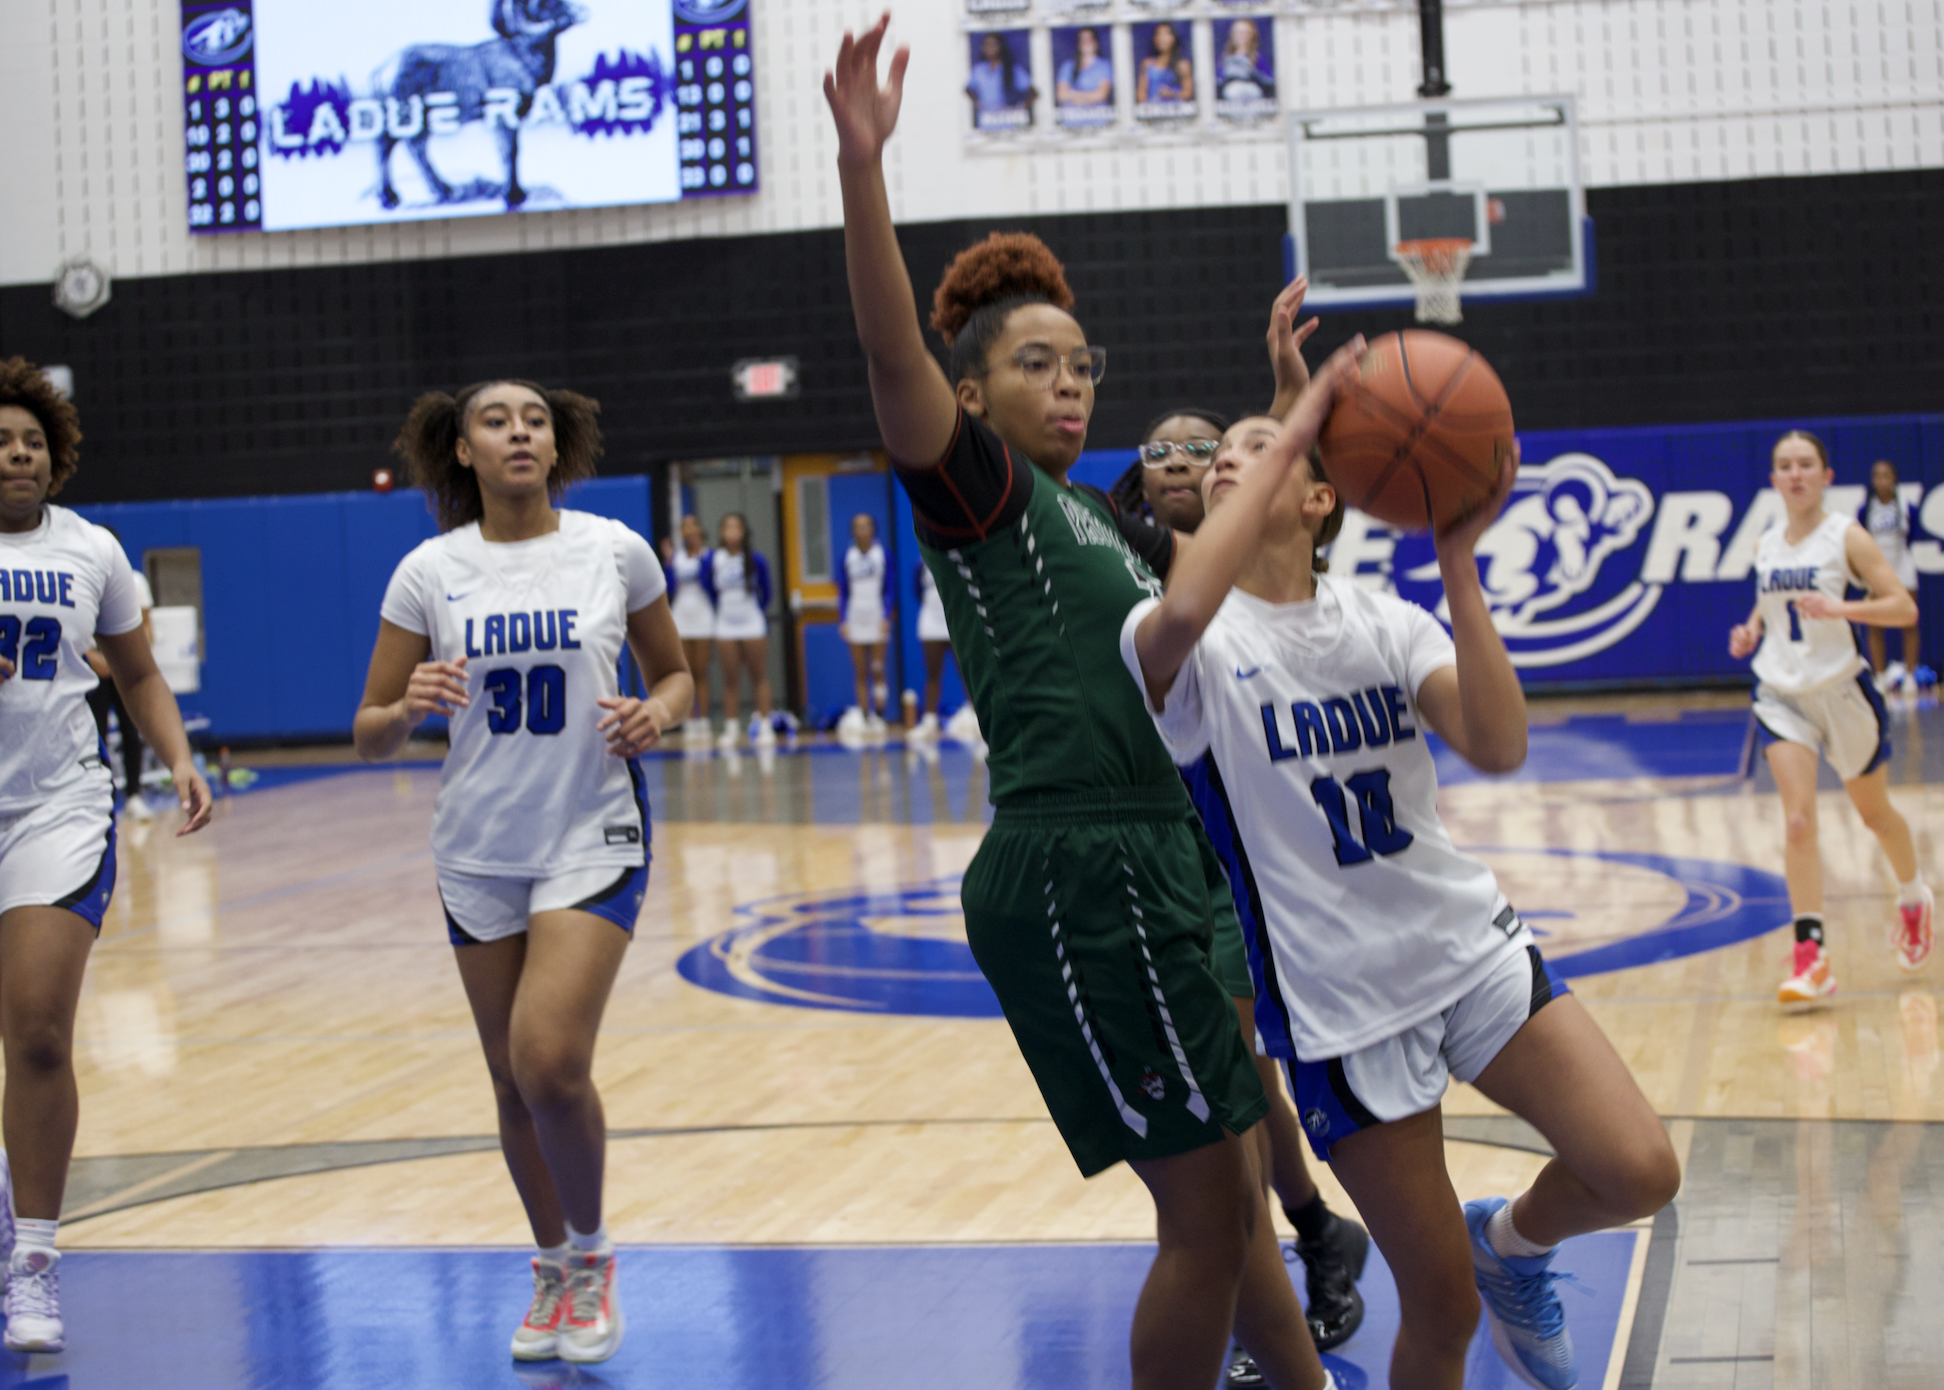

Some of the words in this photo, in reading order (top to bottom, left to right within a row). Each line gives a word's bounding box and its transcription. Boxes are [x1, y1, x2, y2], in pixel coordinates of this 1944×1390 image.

[188, 100, 202, 121] 1
[239, 95, 255, 117] 0
[271, 91, 461, 148] LADUE
[484, 76, 654, 131] RAMS
[240, 120, 257, 142] 0
[241, 146, 258, 169] 0
[243, 173, 259, 195] 0
[244, 199, 260, 221] 0
[0, 568, 76, 610] ADUE
[466, 609, 581, 659] LADUE
[484, 664, 566, 735] 30
[1260, 685, 1416, 765] LADUE
